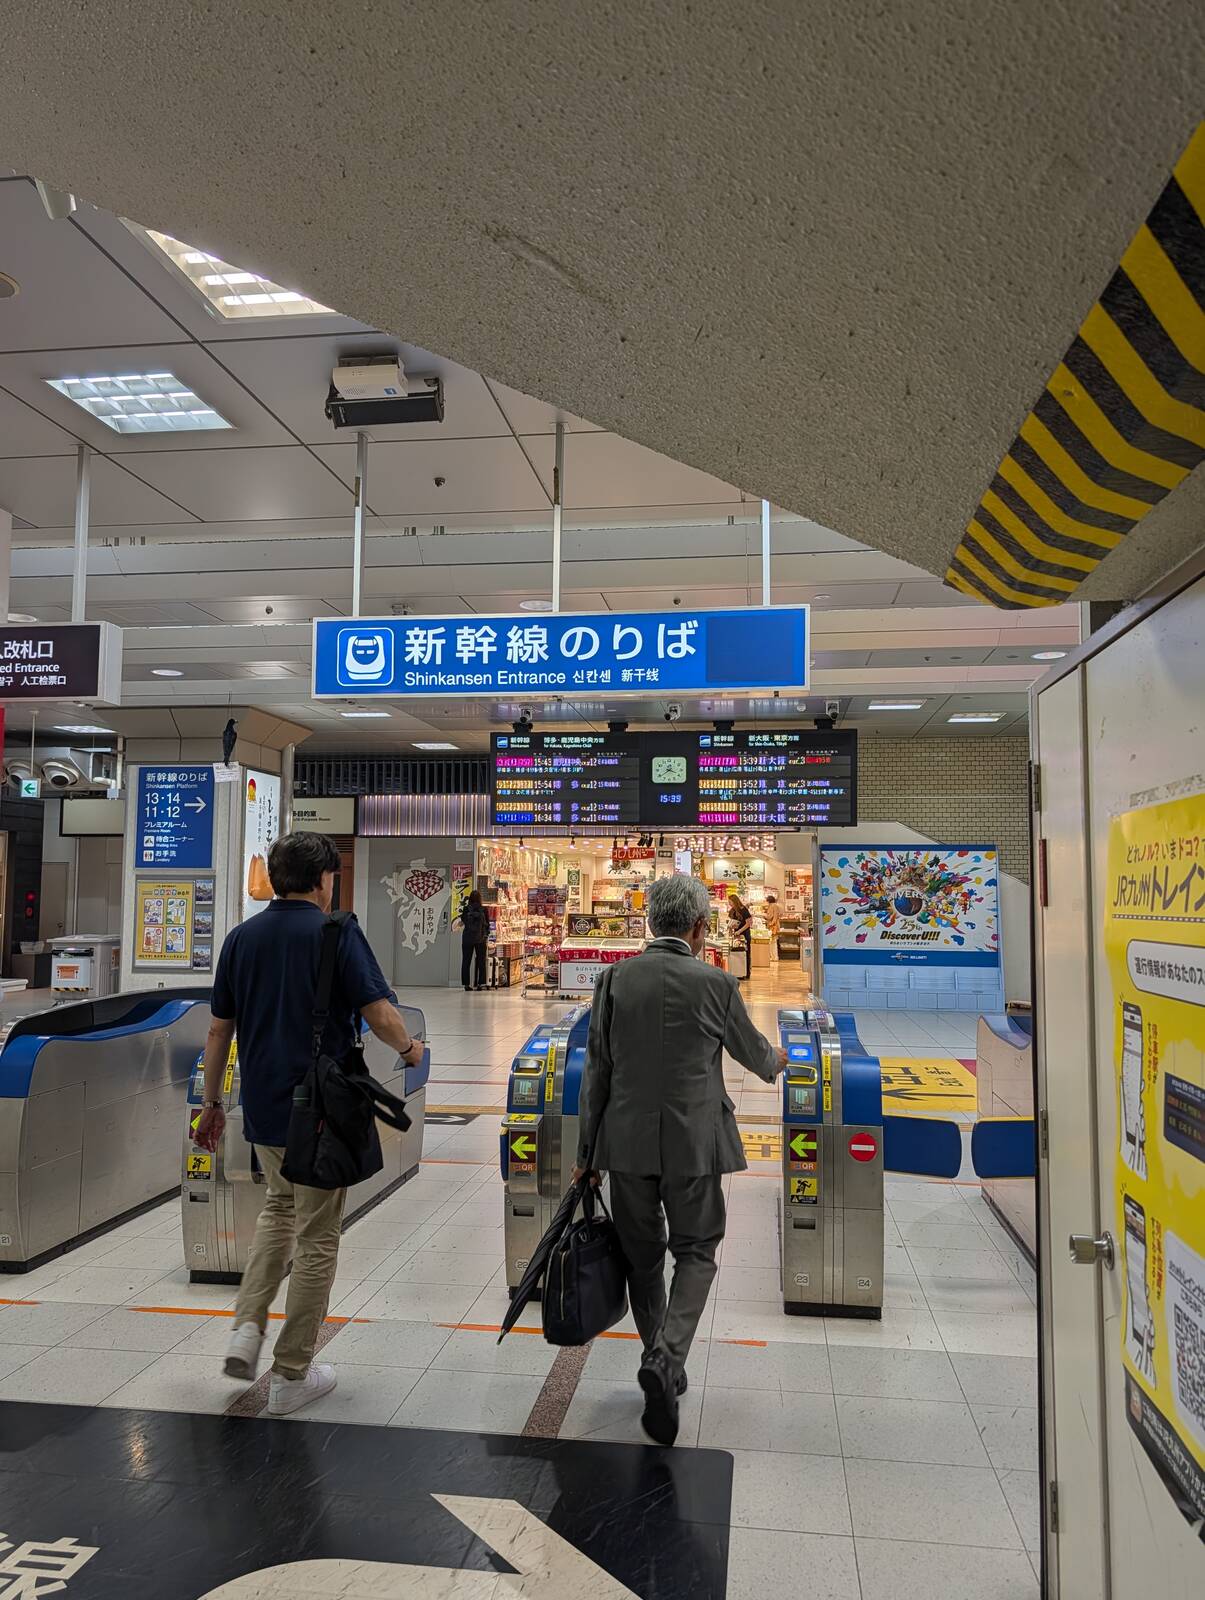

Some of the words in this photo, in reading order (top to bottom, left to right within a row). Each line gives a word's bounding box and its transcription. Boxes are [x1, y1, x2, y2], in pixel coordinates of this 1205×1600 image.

[404, 620, 699, 665] 新幹線のりば
[14, 662, 60, 673] Entrance
[20, 675, 67, 686] 人工检票口
[404, 670, 493, 687] Shinkansen
[497, 669, 566, 686] Entrance
[572, 669, 611, 684] 신칸센
[621, 668, 660, 683] 新干线
[145, 772, 208, 783] 新幹線のりば
[660, 794, 682, 803] 15:39
[155, 835, 195, 843] 待合コーナー
[674, 835, 775, 852] OMIYAGE
[413, 907, 421, 931] 九州
[426, 907, 434, 935] おみやげ
[802, 1162, 815, 1170] QR
[516, 1260, 529, 1269] 22
[796, 1275, 808, 1283] 23
[858, 1279, 870, 1287] 24
